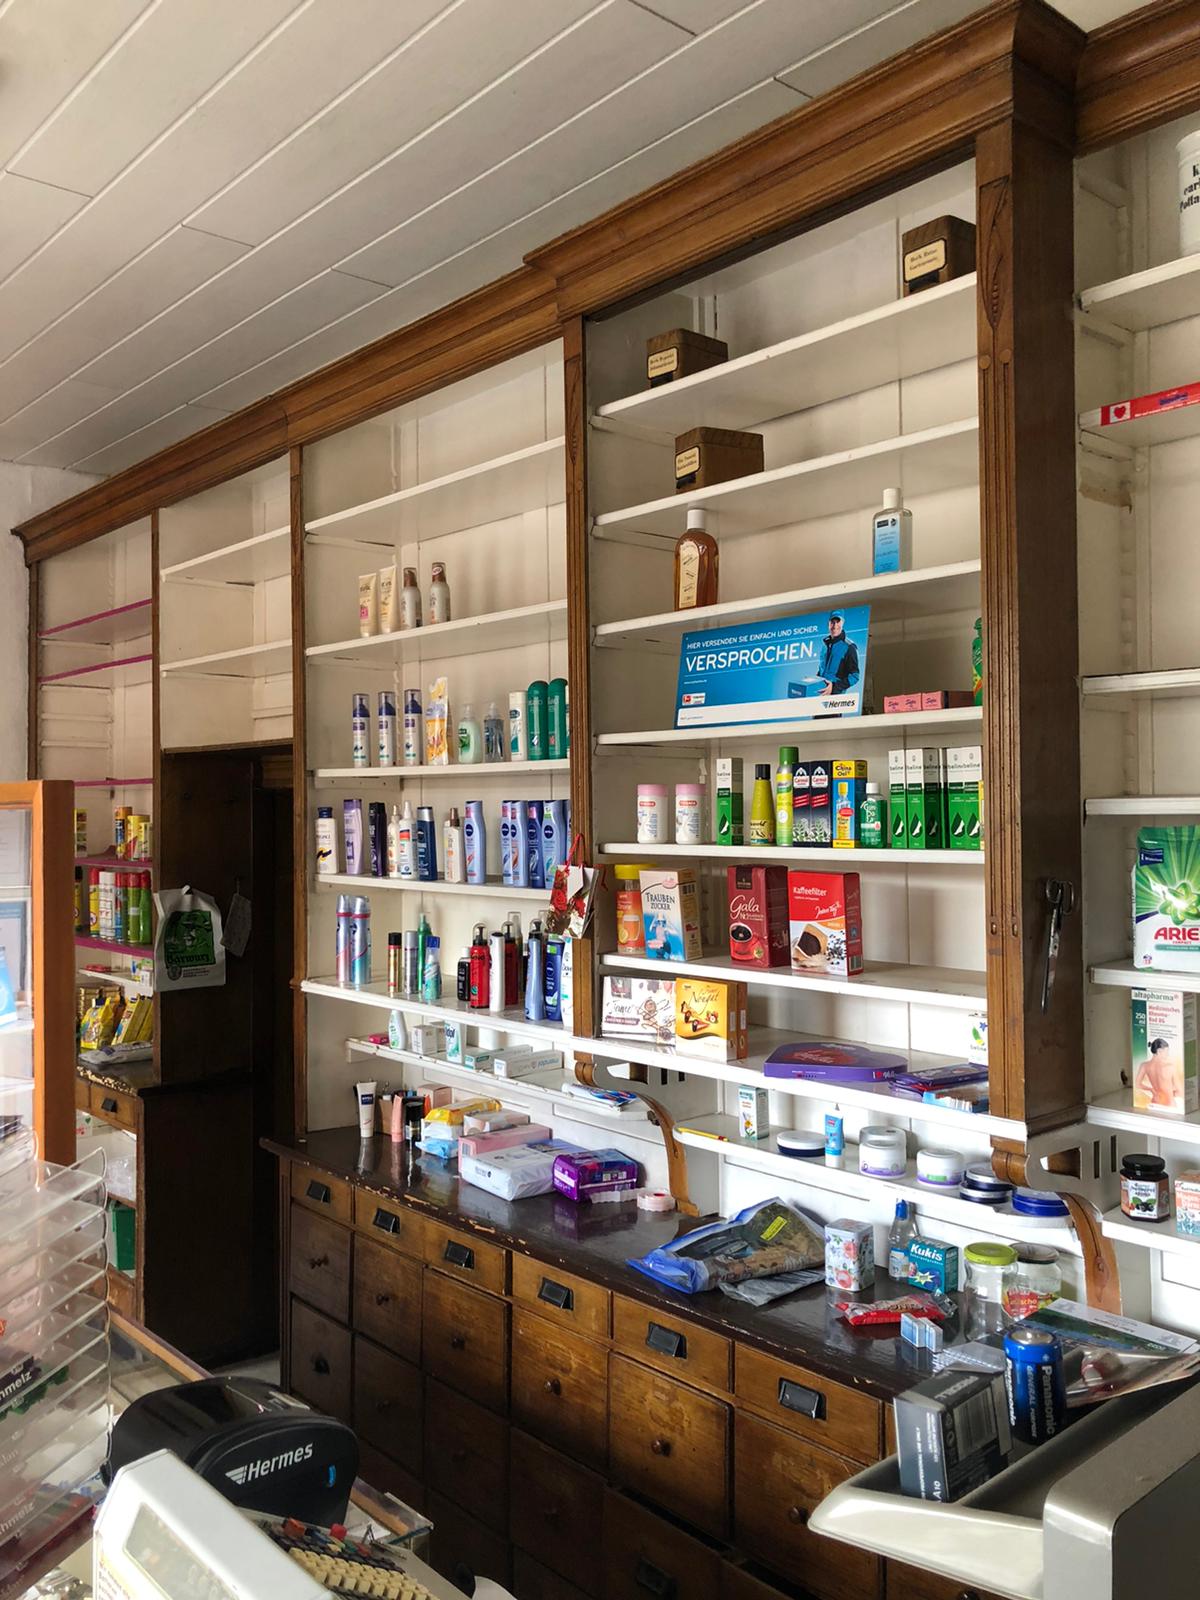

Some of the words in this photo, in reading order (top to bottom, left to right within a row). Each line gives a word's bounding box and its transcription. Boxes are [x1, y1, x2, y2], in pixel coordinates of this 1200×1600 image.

[687, 640, 700, 650] HIER
[702, 636, 738, 648] VERSENDEN
[738, 634, 748, 643] SIE
[750, 630, 776, 642] EINFACH
[778, 629, 792, 638] UND
[793, 625, 819, 636] SICHER
[686, 641, 817, 673] VERSPROCHEN.
[828, 699, 856, 709] Hermes
[645, 892, 676, 904] TRAUBEN
[793, 886, 828, 896] Kaffeefilter
[651, 902, 671, 910] ZUCKER
[730, 894, 760, 920] Gala
[1134, 990, 1174, 1001] altapharma
[911, 1243, 943, 1261] Kukis
[1042, 1365, 1054, 1435] Panasonic
[248, 1442, 313, 1482] Hermes
